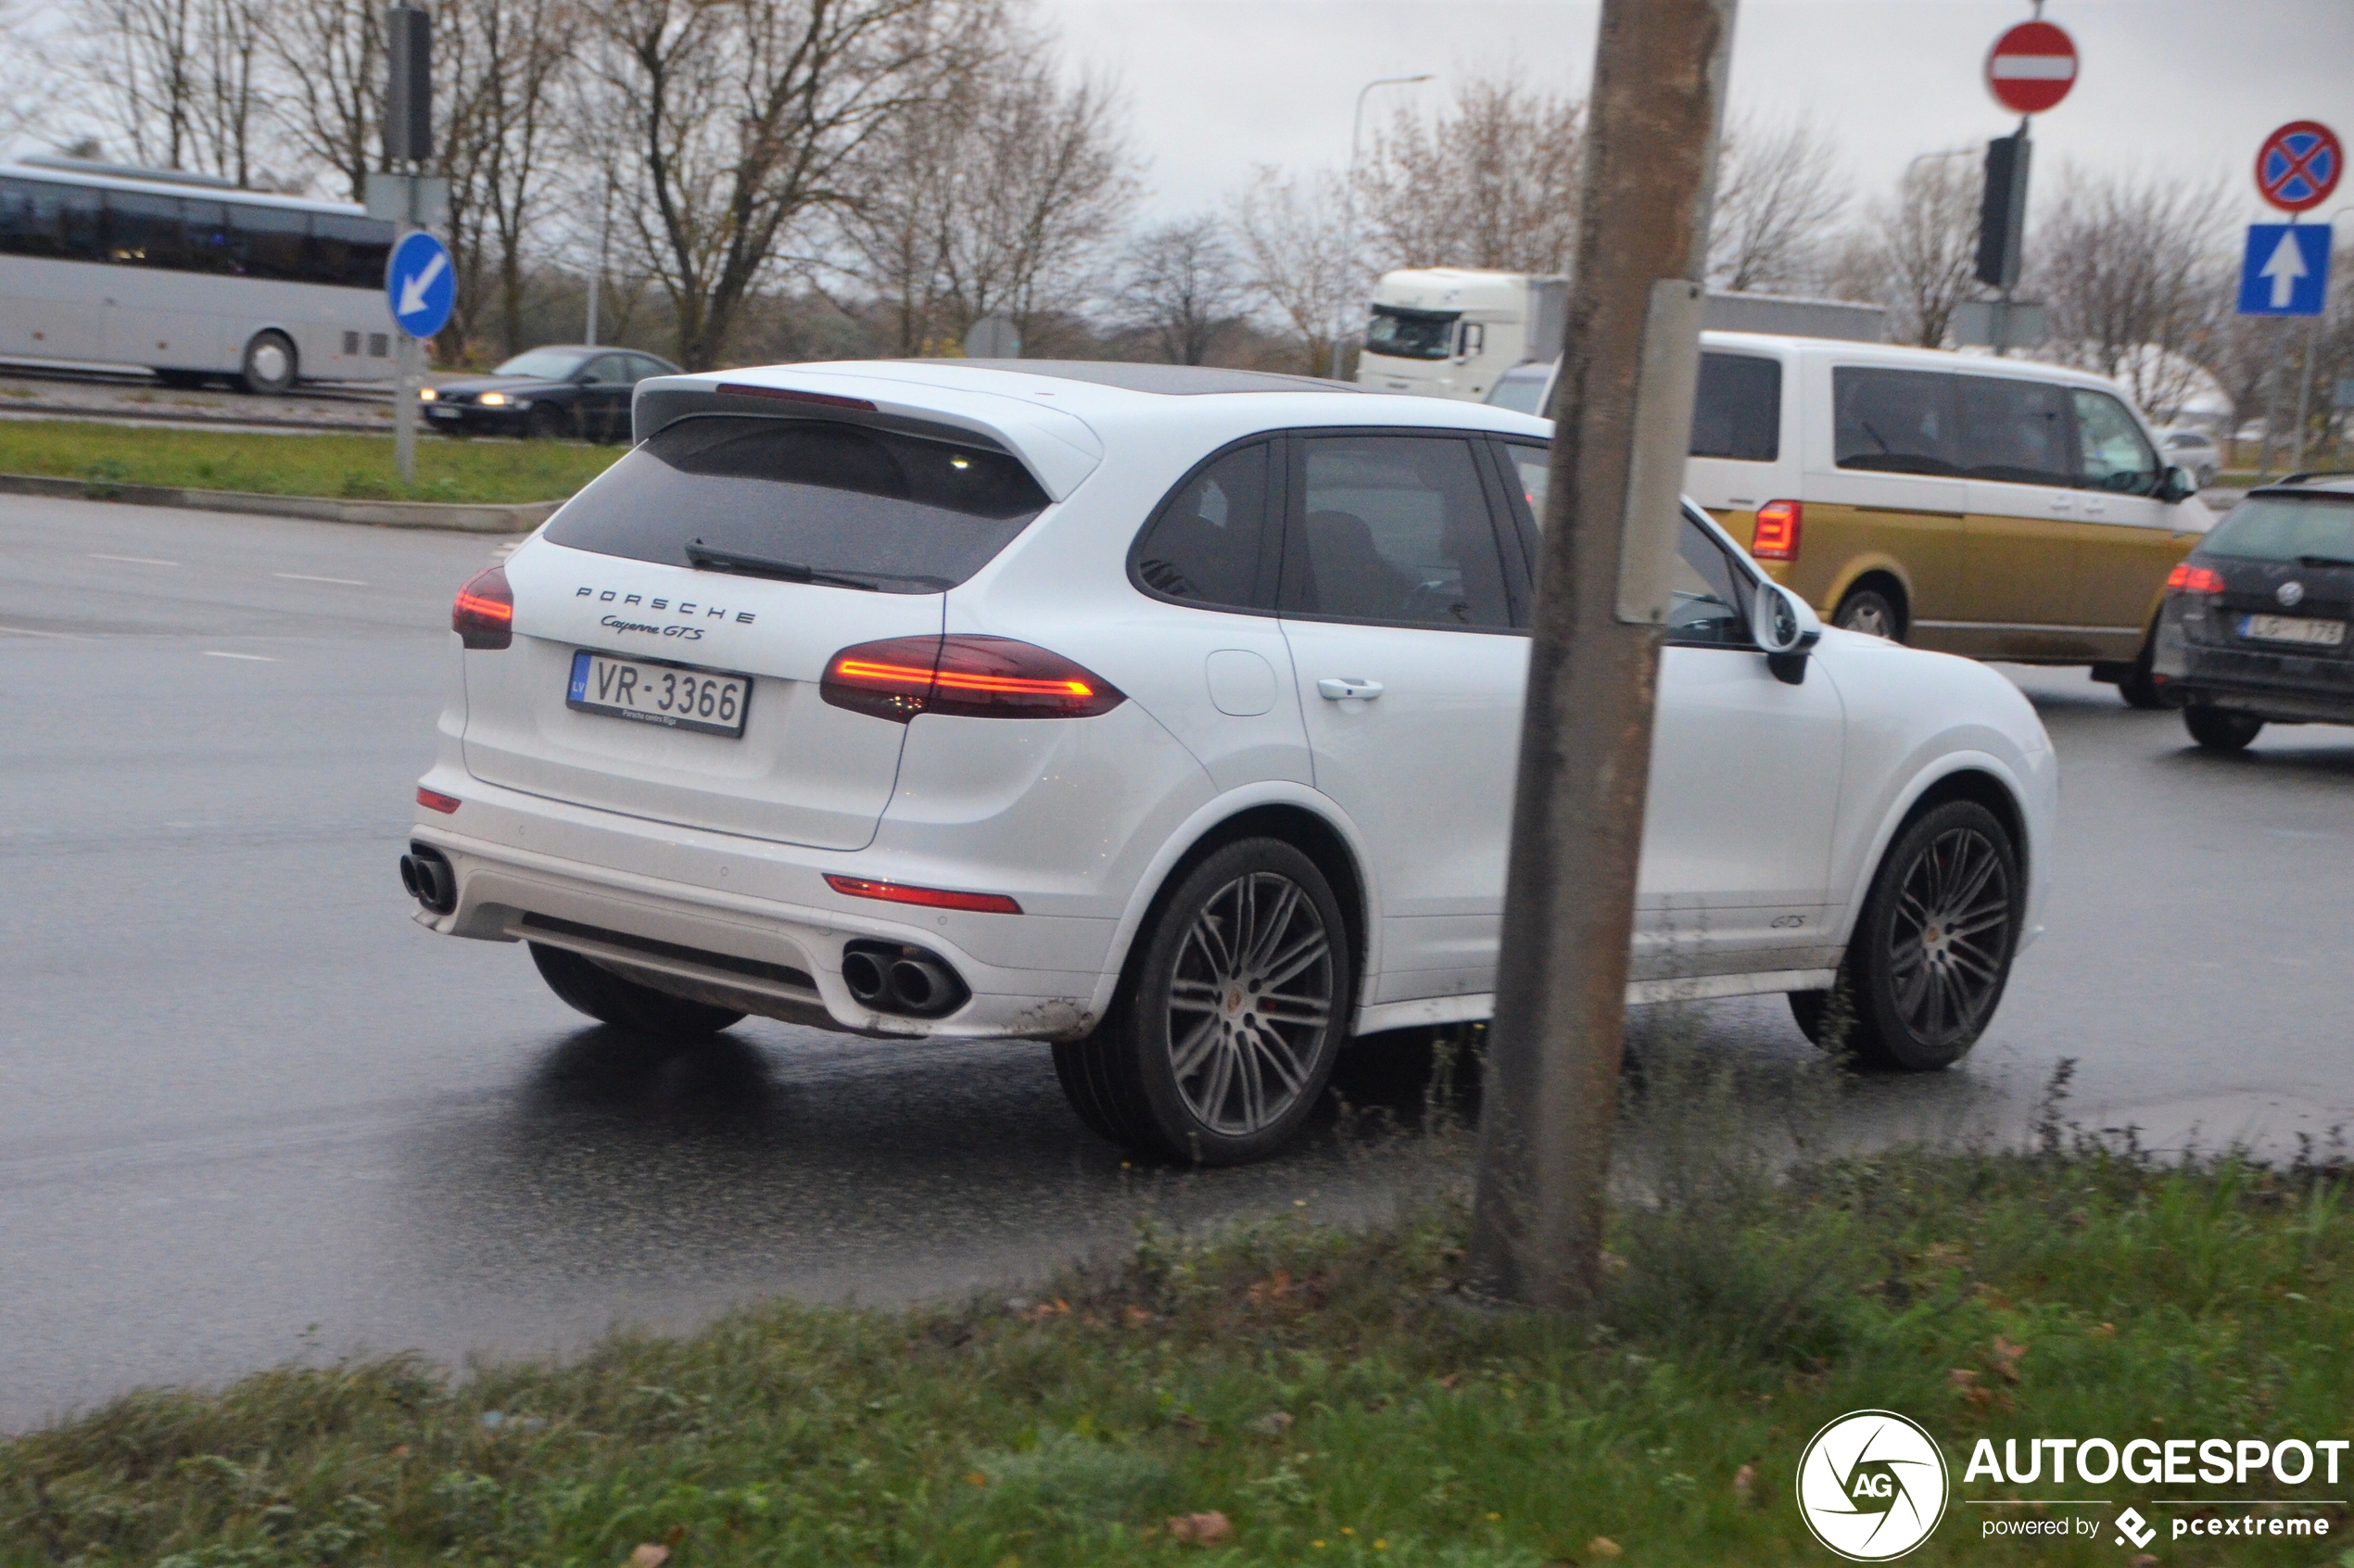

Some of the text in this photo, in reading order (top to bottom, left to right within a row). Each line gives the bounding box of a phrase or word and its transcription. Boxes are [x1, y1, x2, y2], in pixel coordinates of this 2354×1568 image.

[576, 588, 755, 624] PORSCHE
[601, 615, 704, 639] Cayenne GTS
[572, 681, 586, 692] LV
[599, 662, 739, 721] VR-3366
[1771, 915, 1805, 928] GTS
